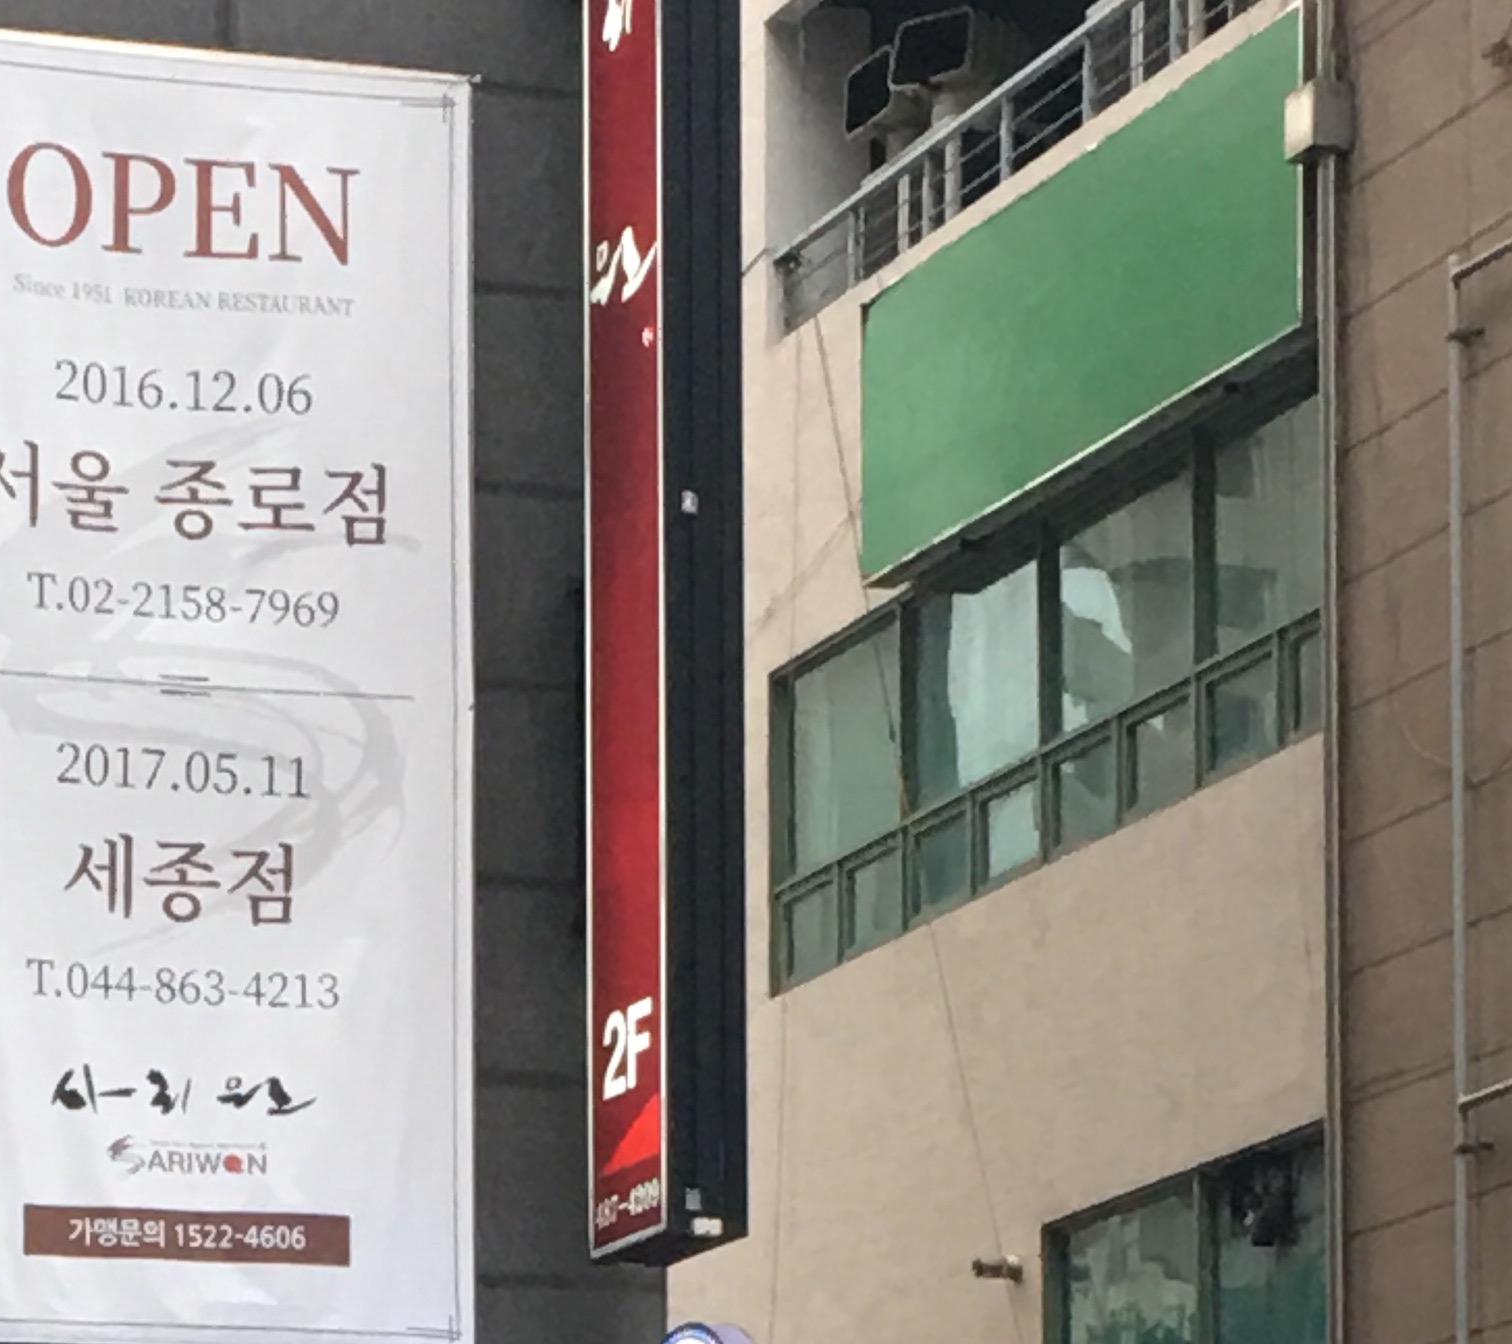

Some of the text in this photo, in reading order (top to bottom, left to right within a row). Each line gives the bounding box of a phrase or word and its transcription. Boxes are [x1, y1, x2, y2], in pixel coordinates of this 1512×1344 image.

[6, 142, 360, 267] OPEN
[12, 273, 66, 300] Since
[123, 287, 212, 311] KOREAN
[217, 291, 355, 318] RESTAURANT
[54, 358, 314, 415] 2016.12.06
[154, 459, 388, 548] 종로점
[26, 570, 340, 628] T.02-2158-7969
[55, 741, 312, 799] 2017.05.11
[63, 832, 295, 927] 세종점
[26, 958, 340, 1010] T.044-863-4213
[602, 996, 653, 1101] 2F
[68, 1216, 307, 1250] 가맹문의 1522-4606
